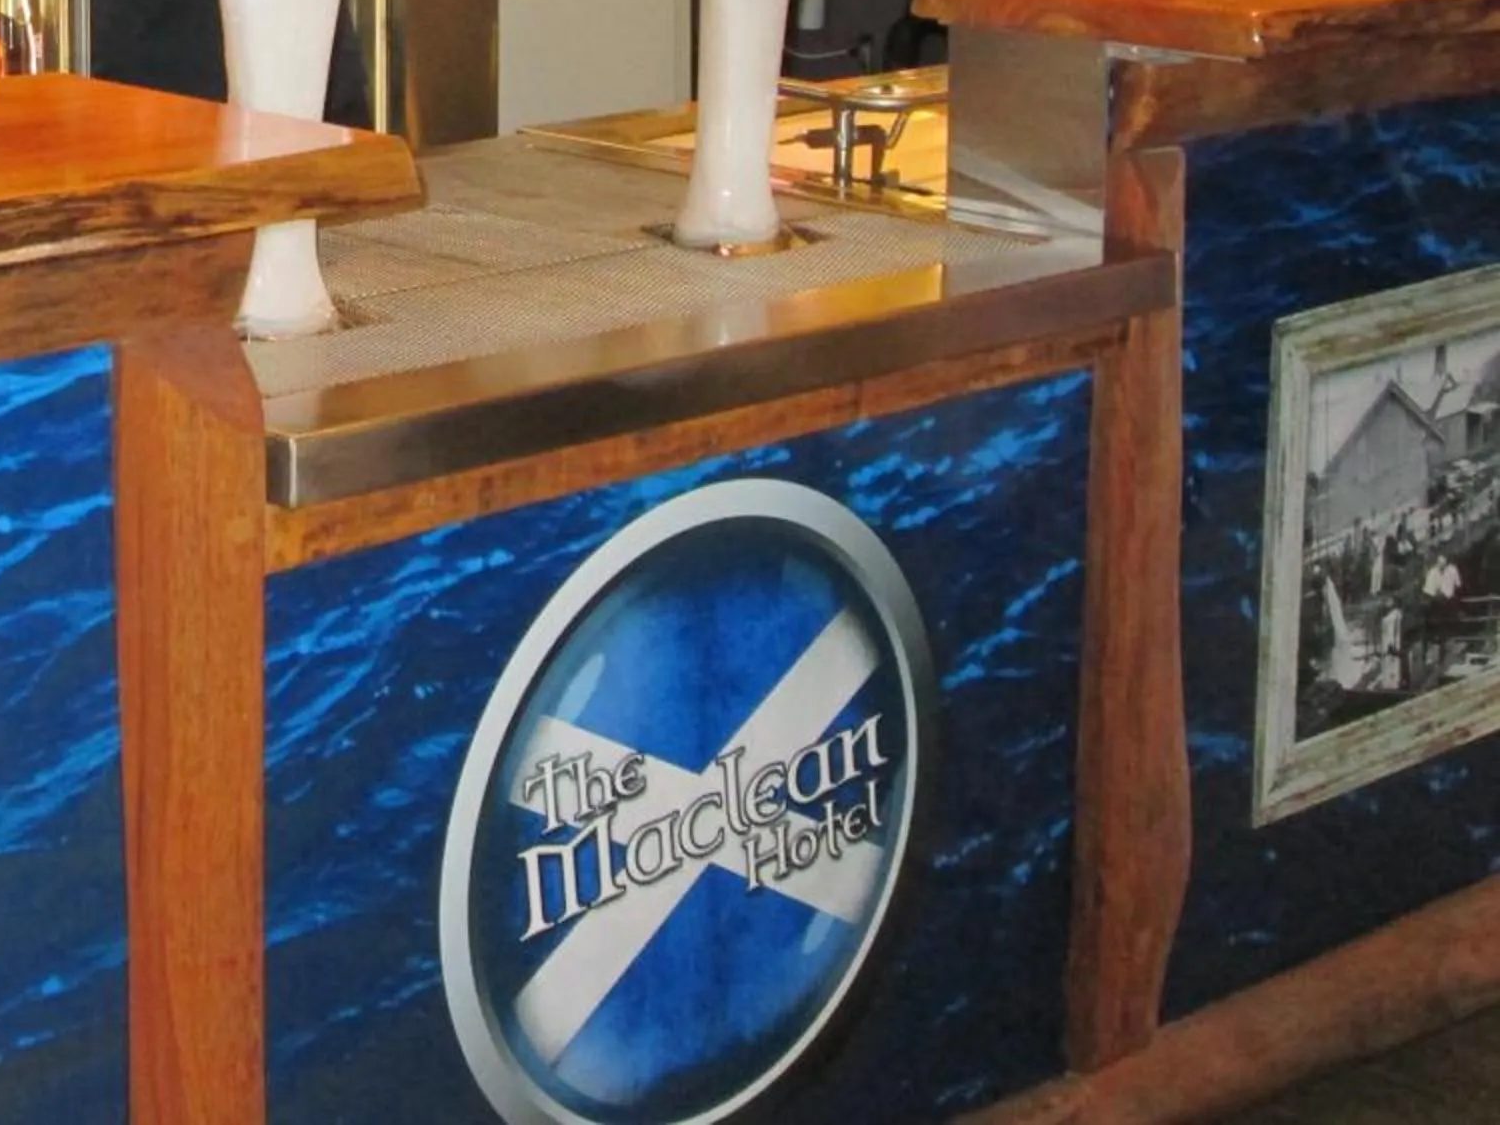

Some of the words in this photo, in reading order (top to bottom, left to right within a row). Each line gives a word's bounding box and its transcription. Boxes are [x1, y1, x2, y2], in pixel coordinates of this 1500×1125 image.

[517, 713, 890, 943] Maclean
[523, 749, 646, 835] The
[743, 779, 884, 892] Hotel
